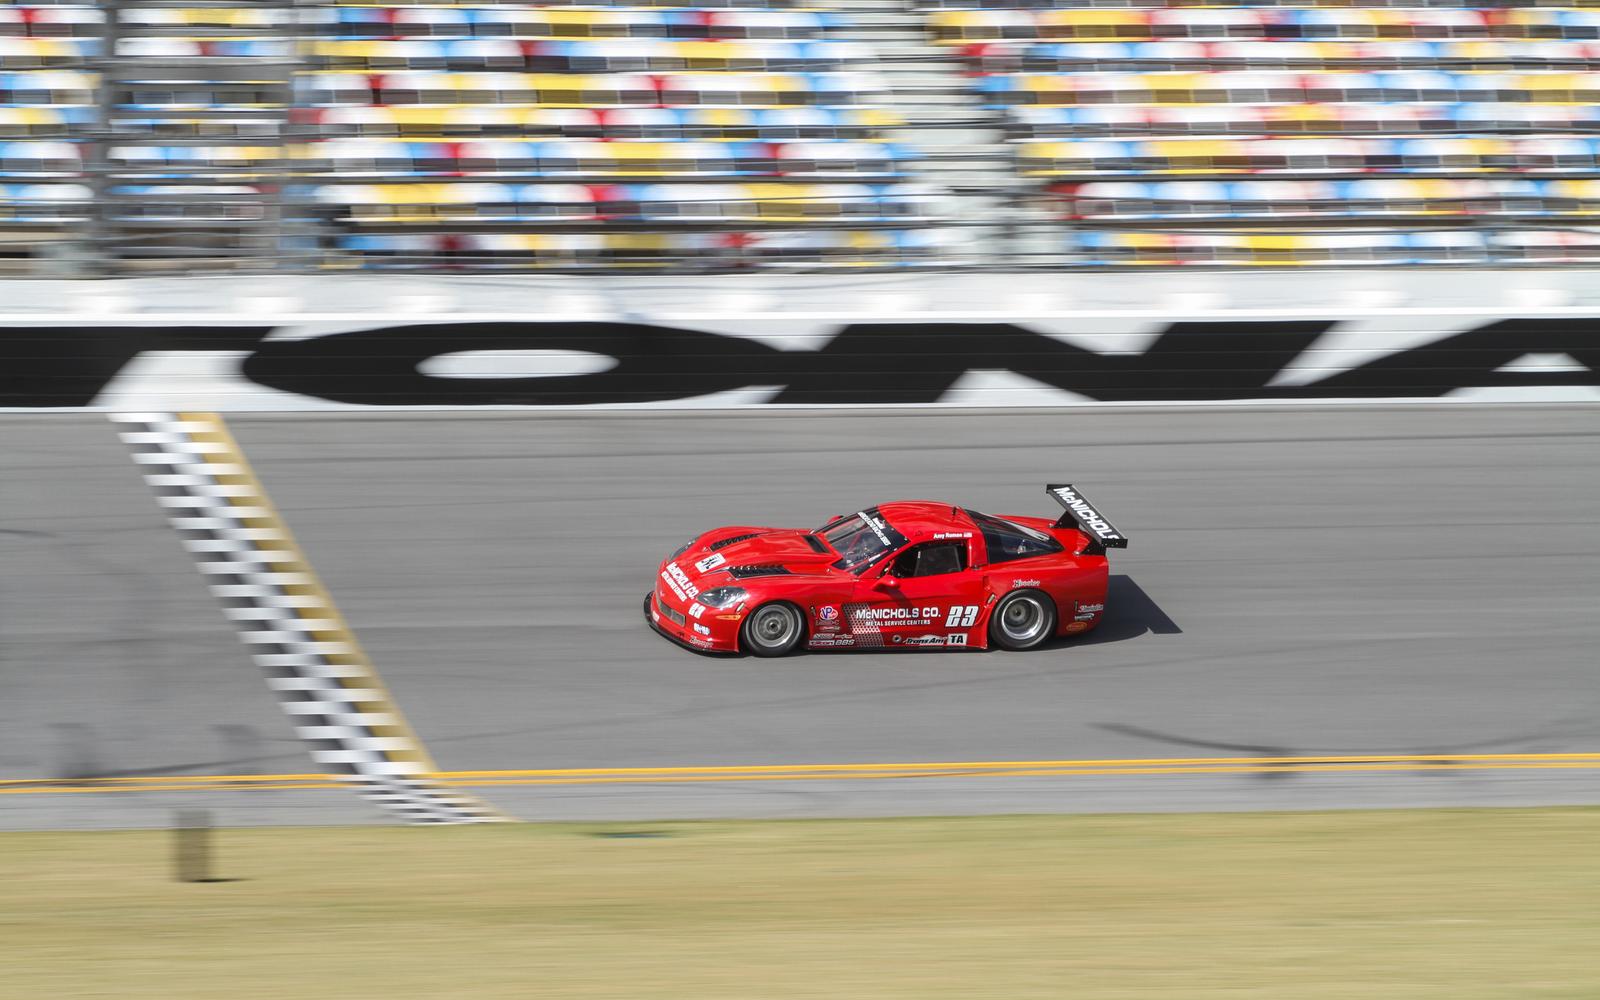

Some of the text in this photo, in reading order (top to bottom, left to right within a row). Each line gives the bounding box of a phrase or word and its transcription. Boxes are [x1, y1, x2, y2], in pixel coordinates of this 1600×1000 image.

[856, 606, 941, 619] McNICHOLS CO.
[945, 605, 979, 627] 23
[885, 619, 906, 627] SERVICE
[950, 635, 964, 644] TA
